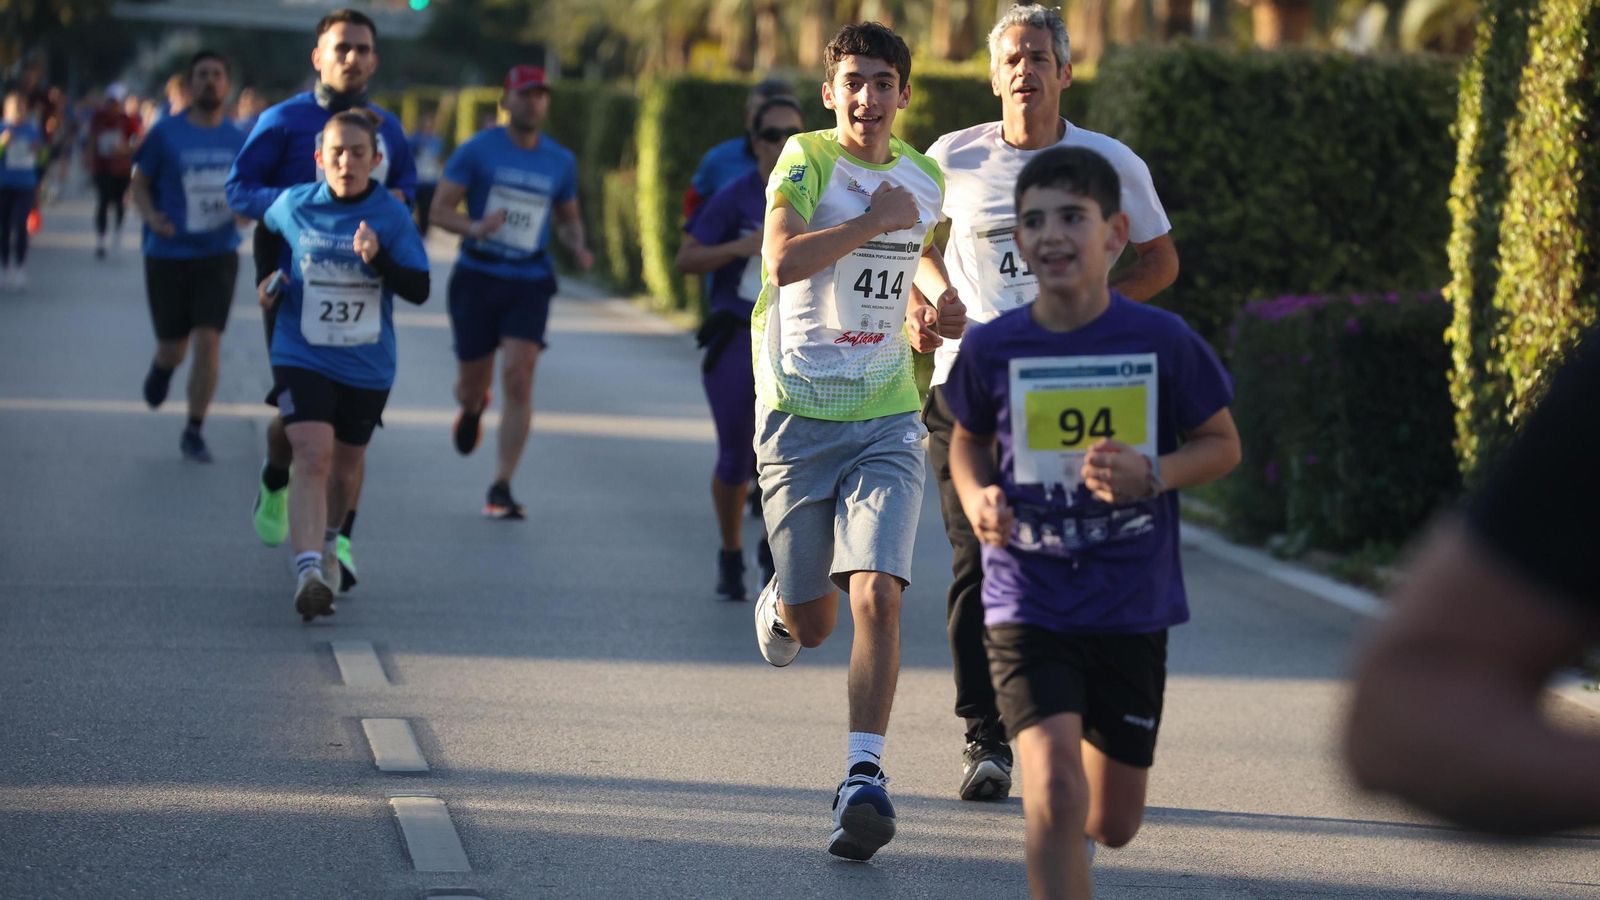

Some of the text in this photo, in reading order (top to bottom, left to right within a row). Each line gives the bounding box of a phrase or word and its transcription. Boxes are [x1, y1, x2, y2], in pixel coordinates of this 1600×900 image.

[853, 268, 904, 299] 414
[319, 300, 365, 323] 237
[1058, 407, 1115, 446] 94
